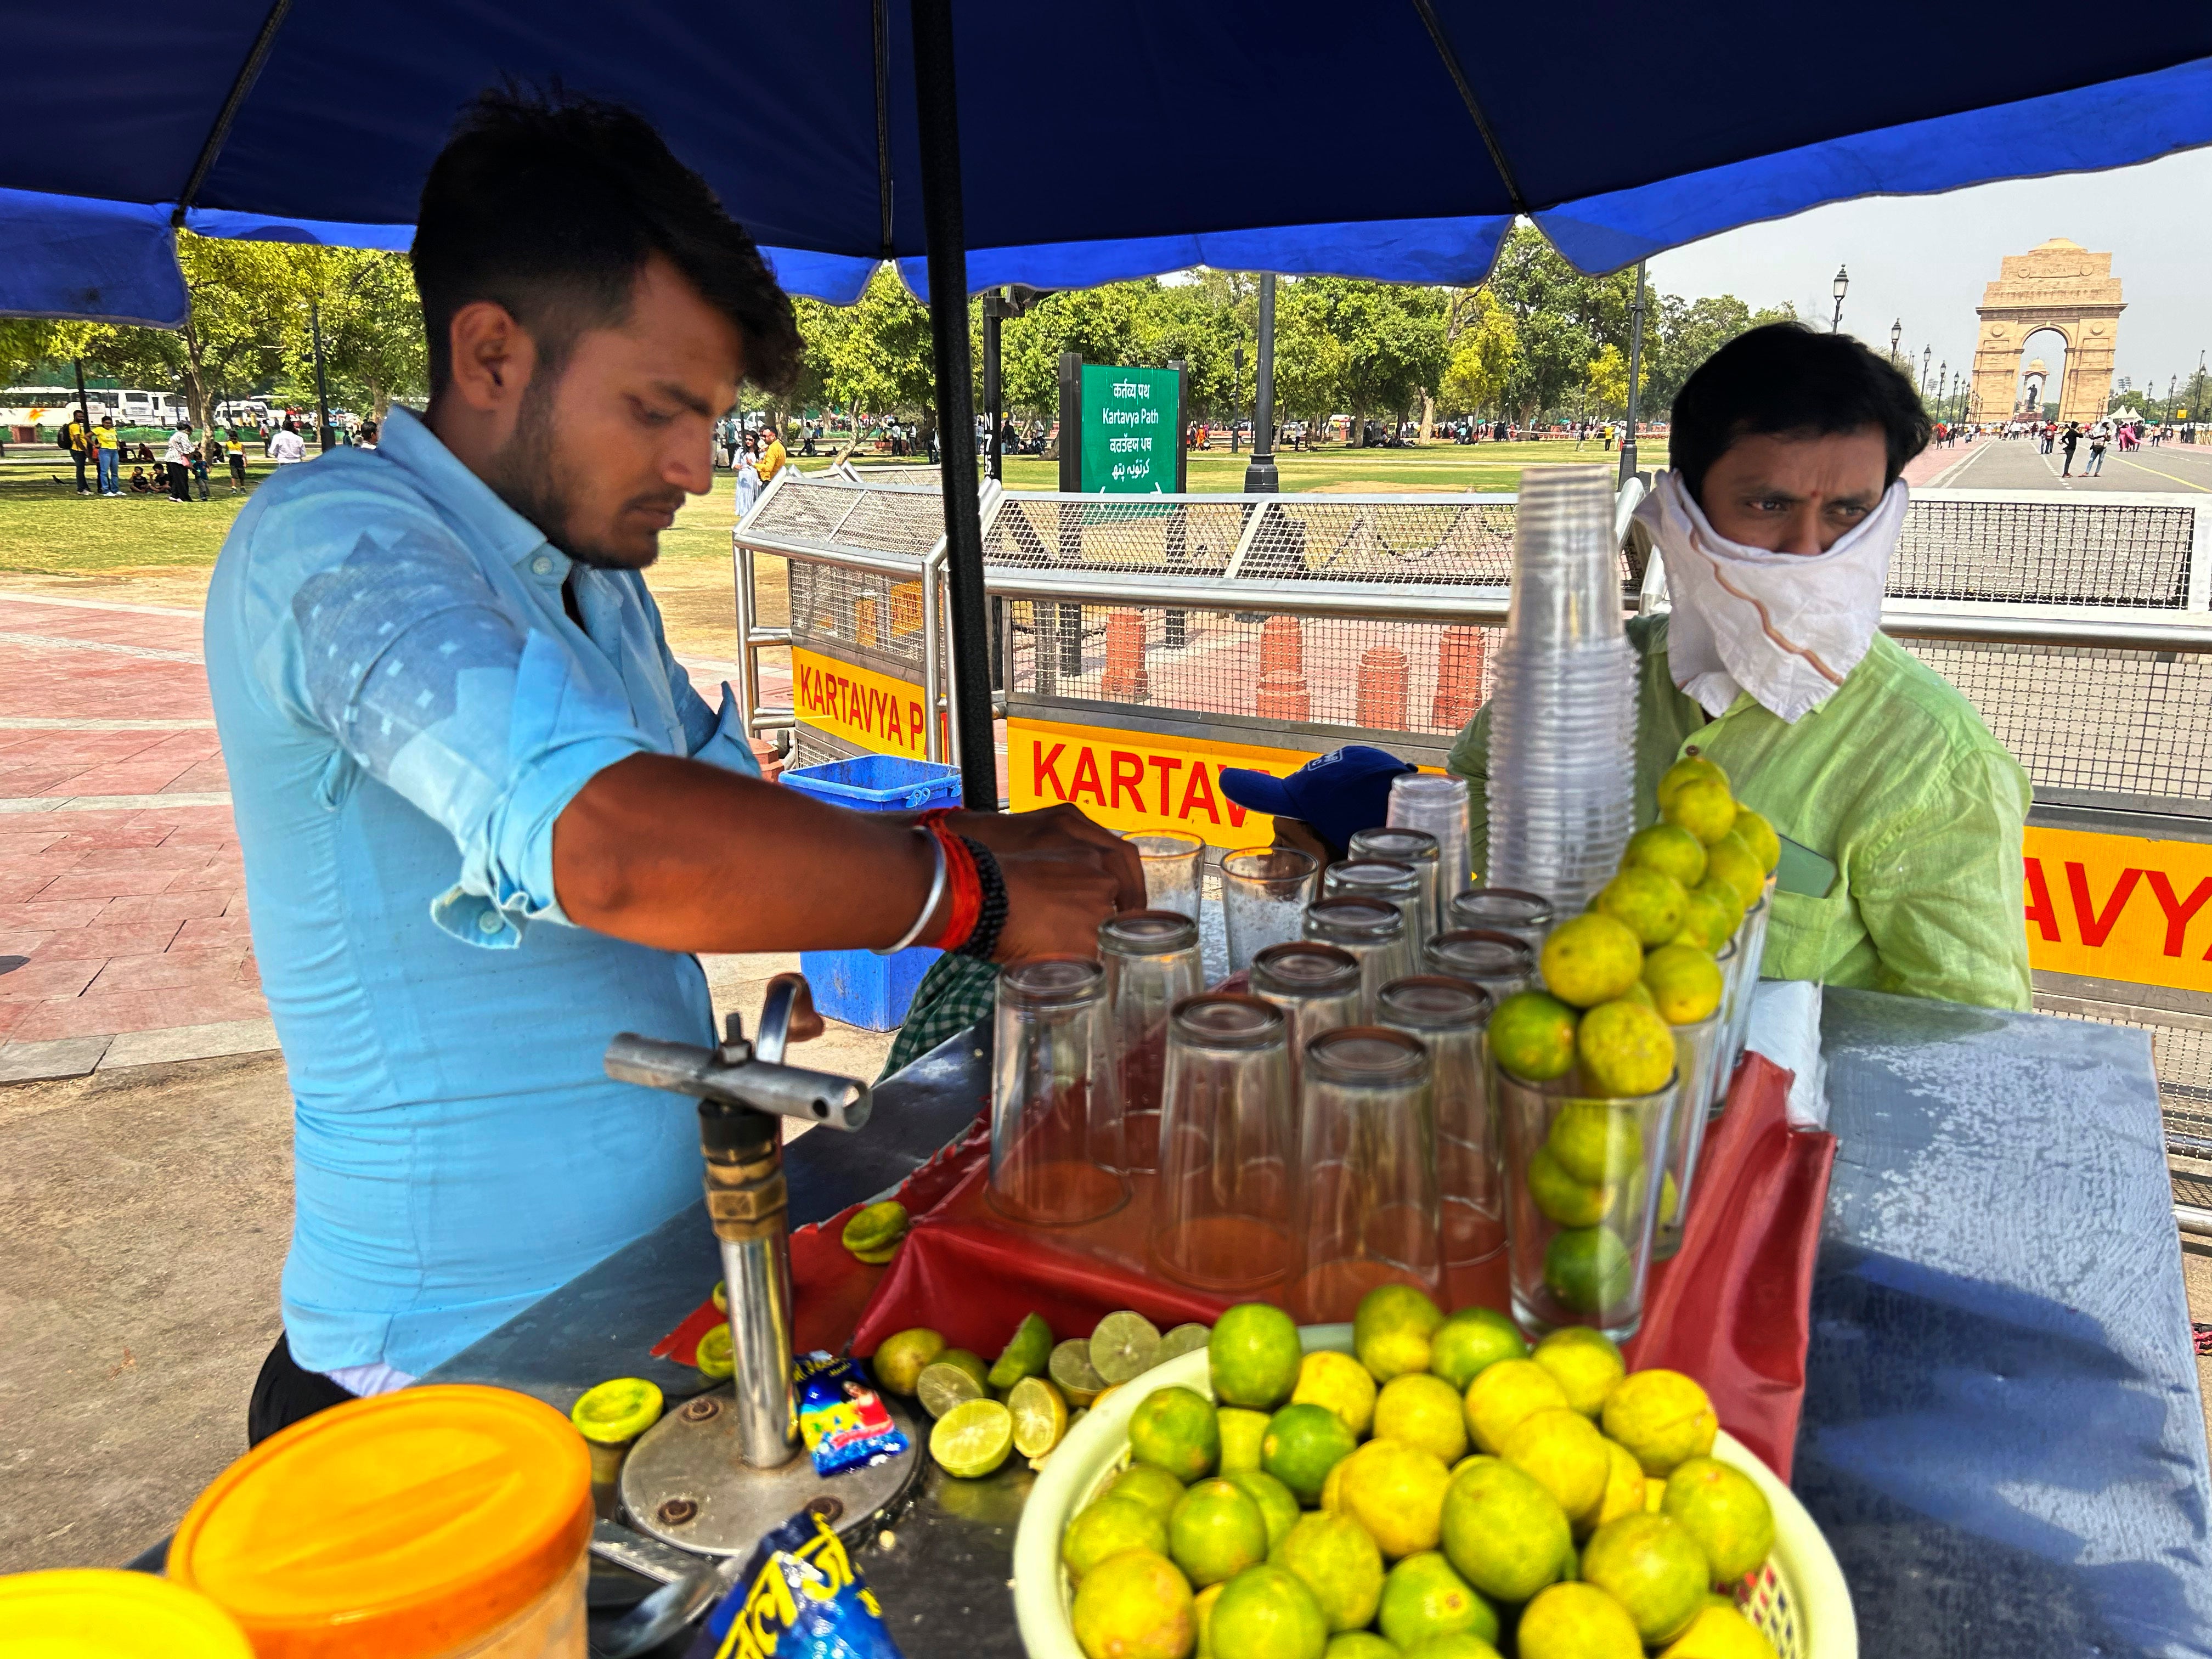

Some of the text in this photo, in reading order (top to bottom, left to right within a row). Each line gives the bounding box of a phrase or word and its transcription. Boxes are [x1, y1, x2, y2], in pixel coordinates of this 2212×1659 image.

[1113, 378, 1150, 399] कर्तव्य पथ
[1103, 408, 1159, 428] Kartavya Path
[800, 664, 903, 746] KARTAVYA
